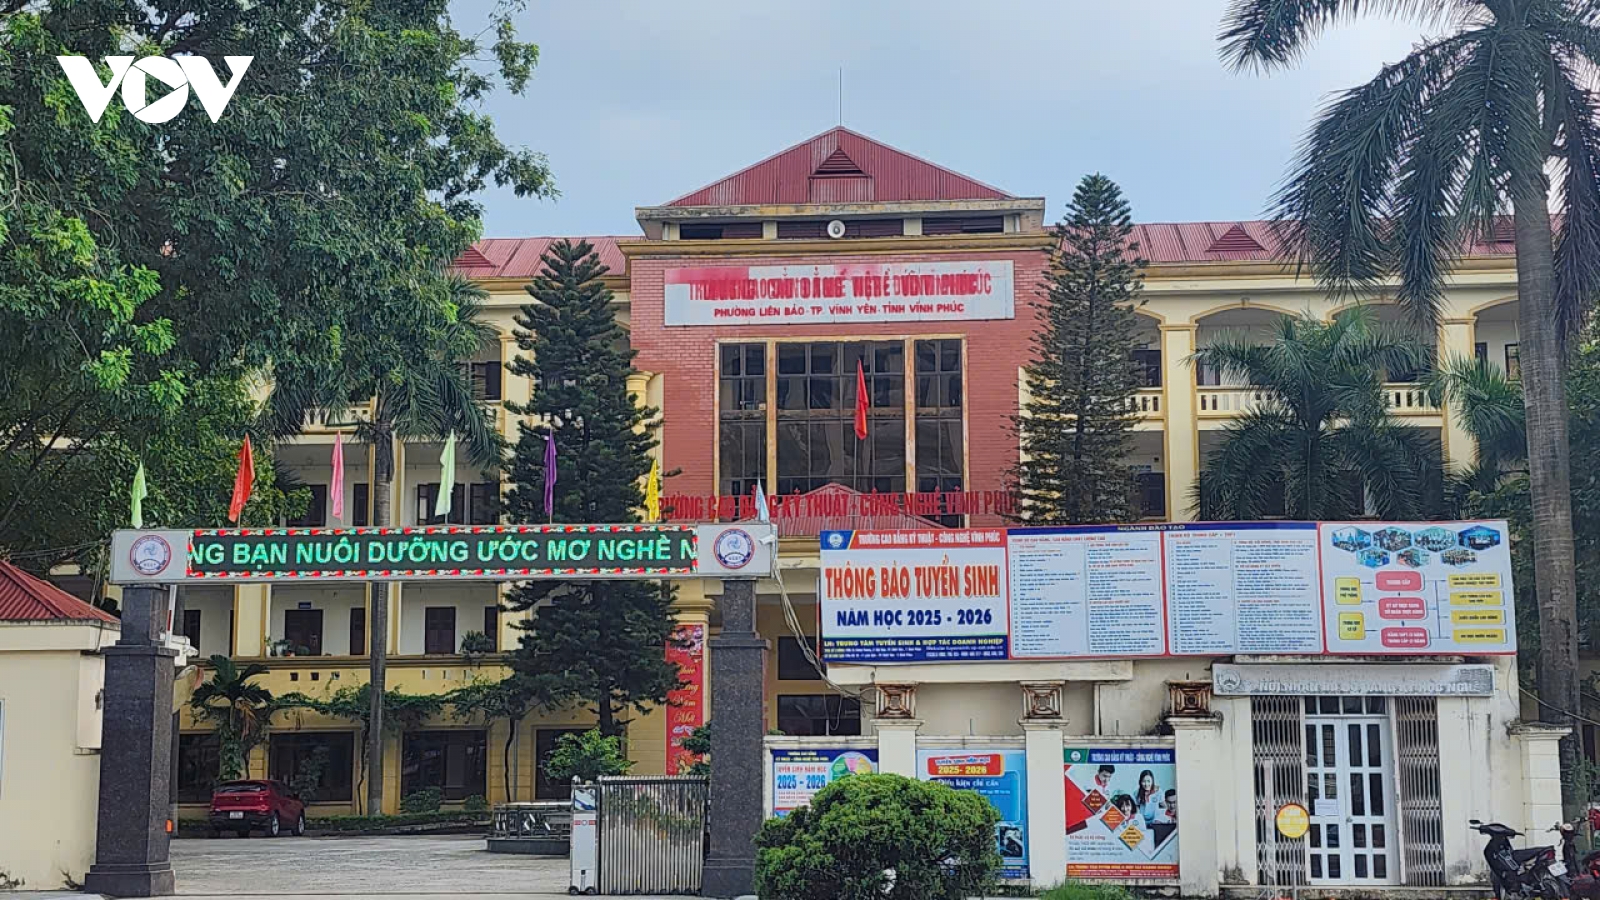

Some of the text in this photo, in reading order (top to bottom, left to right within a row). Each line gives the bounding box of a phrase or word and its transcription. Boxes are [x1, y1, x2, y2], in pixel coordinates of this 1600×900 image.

[760, 305, 780, 316] LIÊN
[857, 303, 877, 314] YÊN
[937, 301, 964, 313] PHÚC
[233, 543, 288, 570] BẠN
[295, 537, 360, 564] NUÔI
[368, 536, 469, 564] DƯỠNG
[477, 534, 539, 562] ƯỚC
[547, 538, 591, 561] MƠ
[825, 552, 1000, 599] THÔNG BÁO TUYỂN SINH
[837, 608, 870, 627] NĂM
[873, 610, 903, 630] HỌC
[907, 609, 942, 626] 2025
[957, 608, 992, 625] 2026
[965, 765, 987, 775] 2026
[777, 774, 797, 790] 2025
[806, 774, 826, 790] 2026
